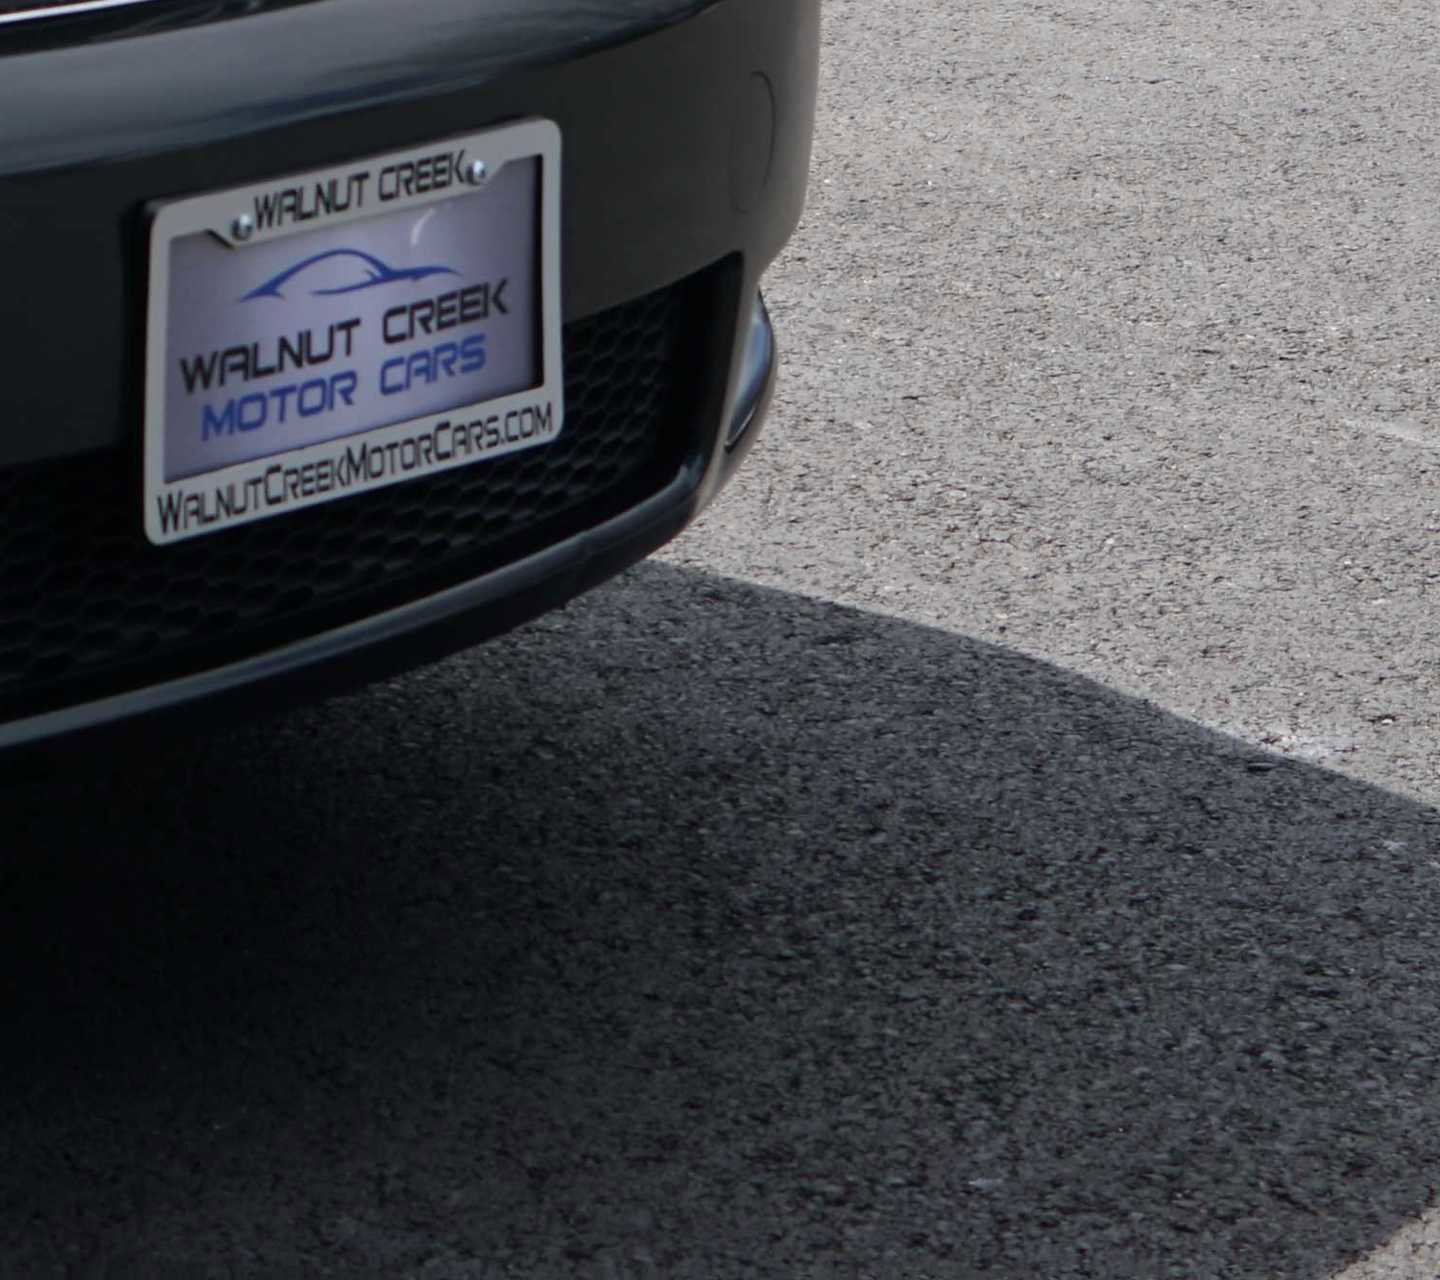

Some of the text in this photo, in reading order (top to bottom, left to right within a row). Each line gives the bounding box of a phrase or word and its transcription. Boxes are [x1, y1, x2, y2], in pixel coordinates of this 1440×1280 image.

[253, 148, 466, 230] WALNUT CREEK
[180, 278, 510, 394] WALNUT CREEK
[200, 334, 487, 440] MOTOR CARS
